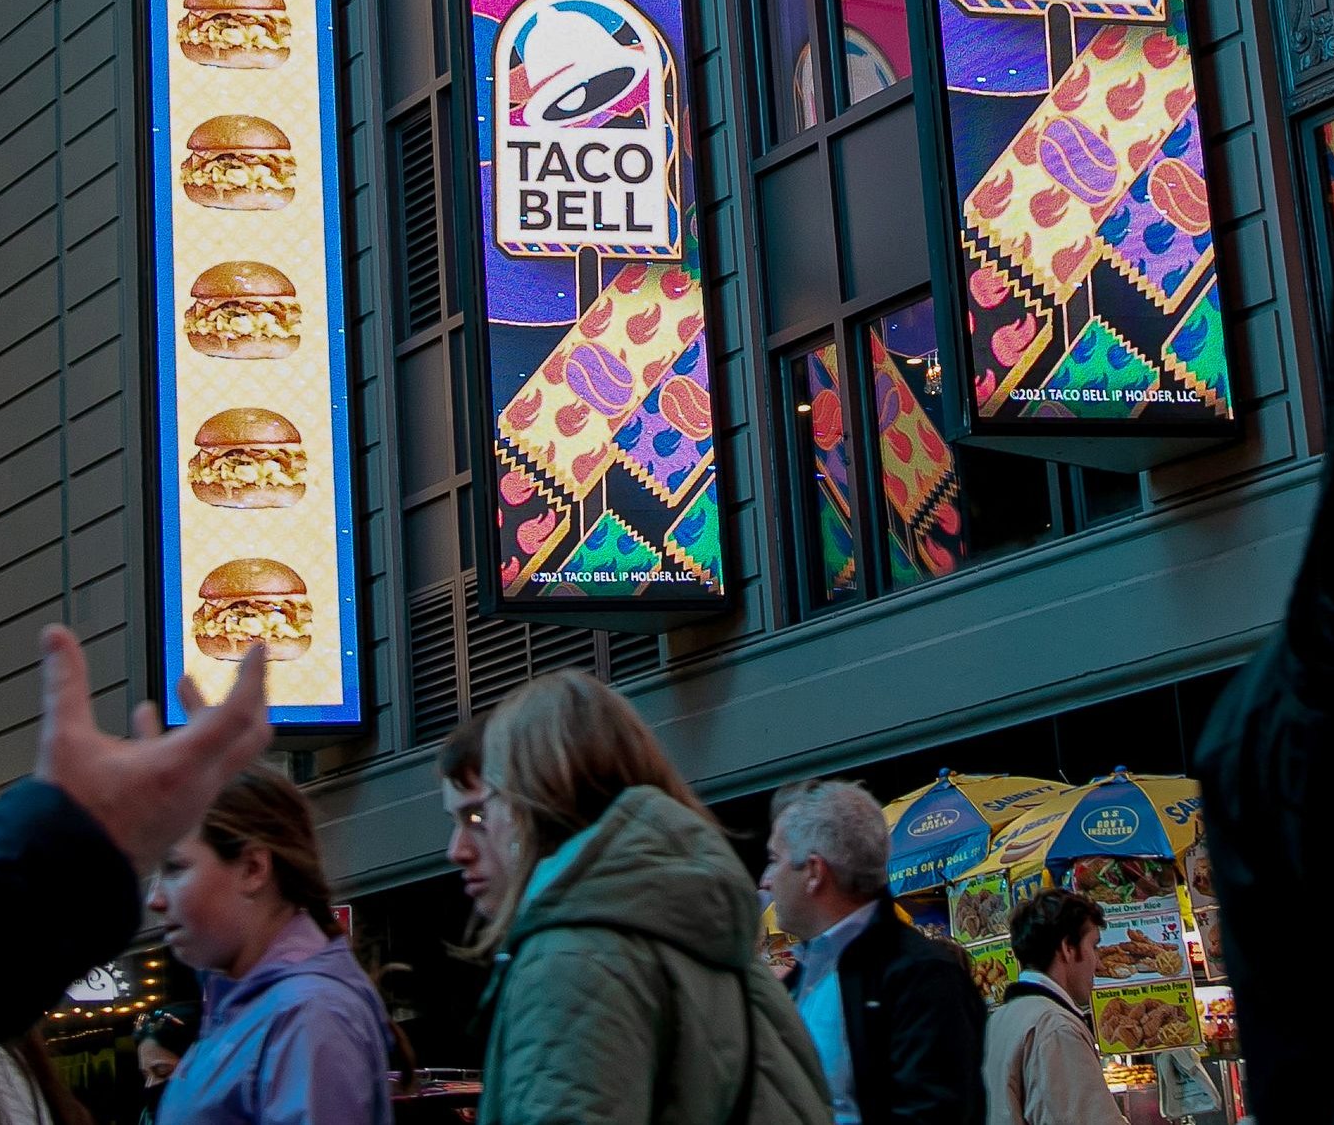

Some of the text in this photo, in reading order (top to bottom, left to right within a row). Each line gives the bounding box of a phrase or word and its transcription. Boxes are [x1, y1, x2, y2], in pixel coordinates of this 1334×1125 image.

[506, 141, 654, 184] TACO
[519, 189, 653, 232] BELL
[1048, 389, 1081, 401] TACO
[1083, 389, 1110, 402] BELL
[1111, 390, 1123, 402] IP
[1125, 390, 1175, 403] HOLDER,
[1176, 390, 1201, 403] LLC.
[564, 572, 593, 583] TACO
[594, 572, 618, 583] BELL
[619, 572, 629, 582] IP
[631, 572, 674, 583] HOLDER,
[676, 571, 696, 582] LLC.
[983, 785, 1055, 812] SABRETT
[1087, 826, 1133, 836] INSPECTED
[920, 861, 935, 872] ON
[936, 858, 944, 869] A
[946, 852, 969, 866] ROLL
[1123, 904, 1142, 912] Over
[1161, 930, 1180, 942] NY
[1096, 990, 1120, 1000] Chicken
[1121, 987, 1140, 996] Wings
[1150, 984, 1171, 994] French
